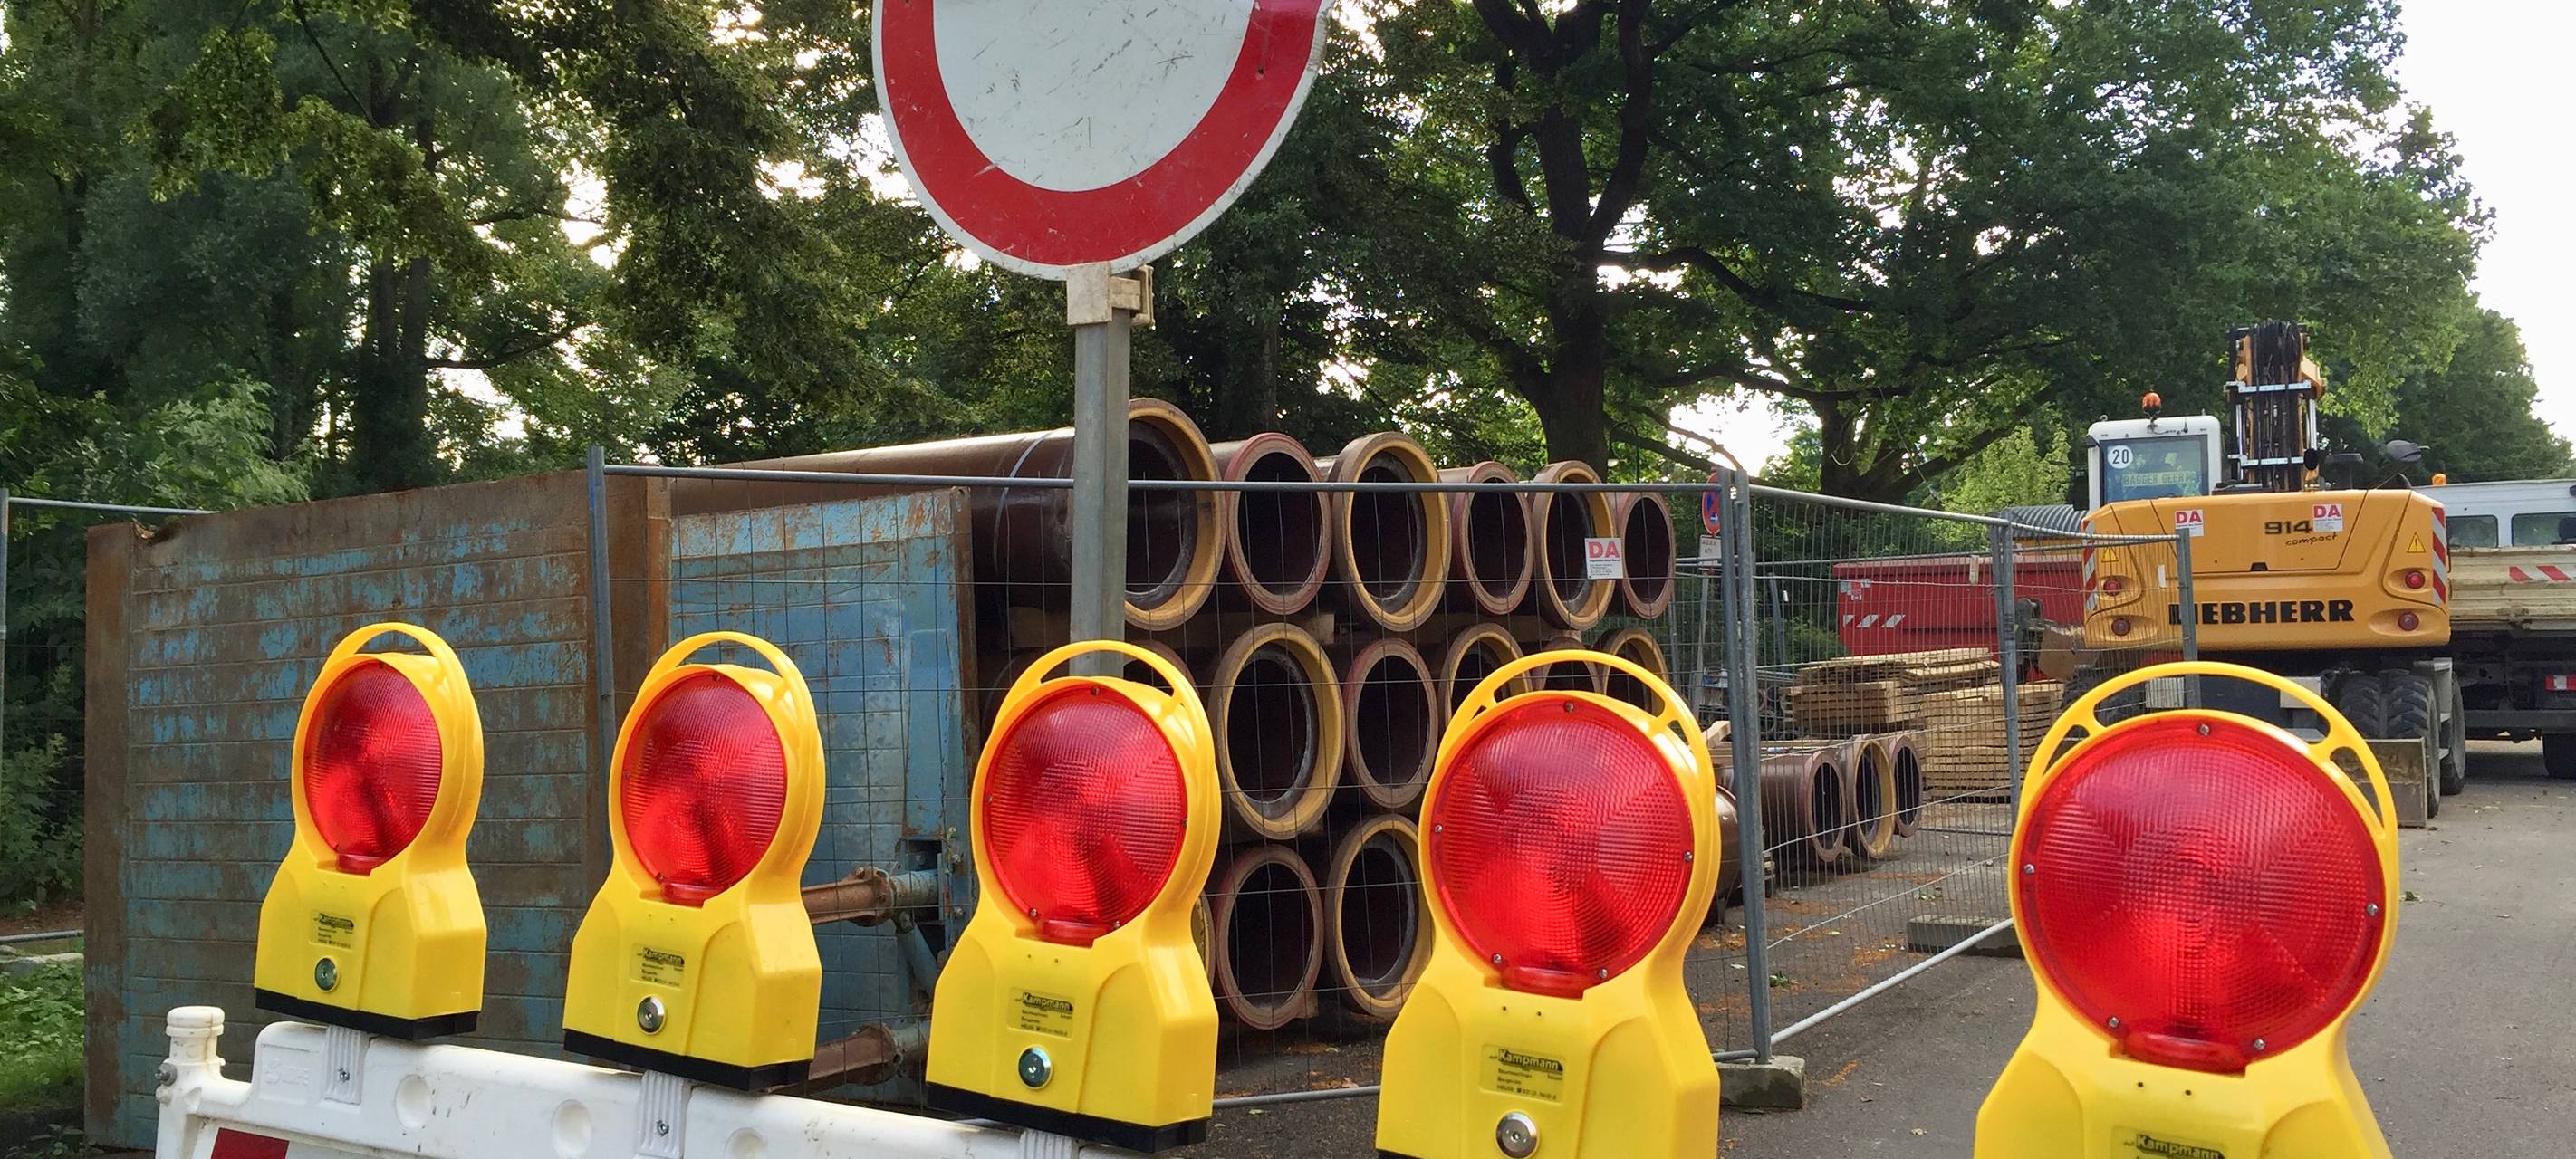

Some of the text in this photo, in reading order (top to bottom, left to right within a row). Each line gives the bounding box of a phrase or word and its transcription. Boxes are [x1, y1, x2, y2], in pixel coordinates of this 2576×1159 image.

[2112, 449, 2129, 464] 20
[2176, 511, 2202, 523] DA
[2313, 505, 2341, 518] DA
[2264, 520, 2313, 534] 914
[2285, 531, 2337, 545] compact
[1588, 541, 1620, 558] DA
[1023, 992, 1071, 1011] Kampmann
[1498, 1050, 1559, 1072] Kampmann
[2137, 1135, 2220, 1159] Kampmann
